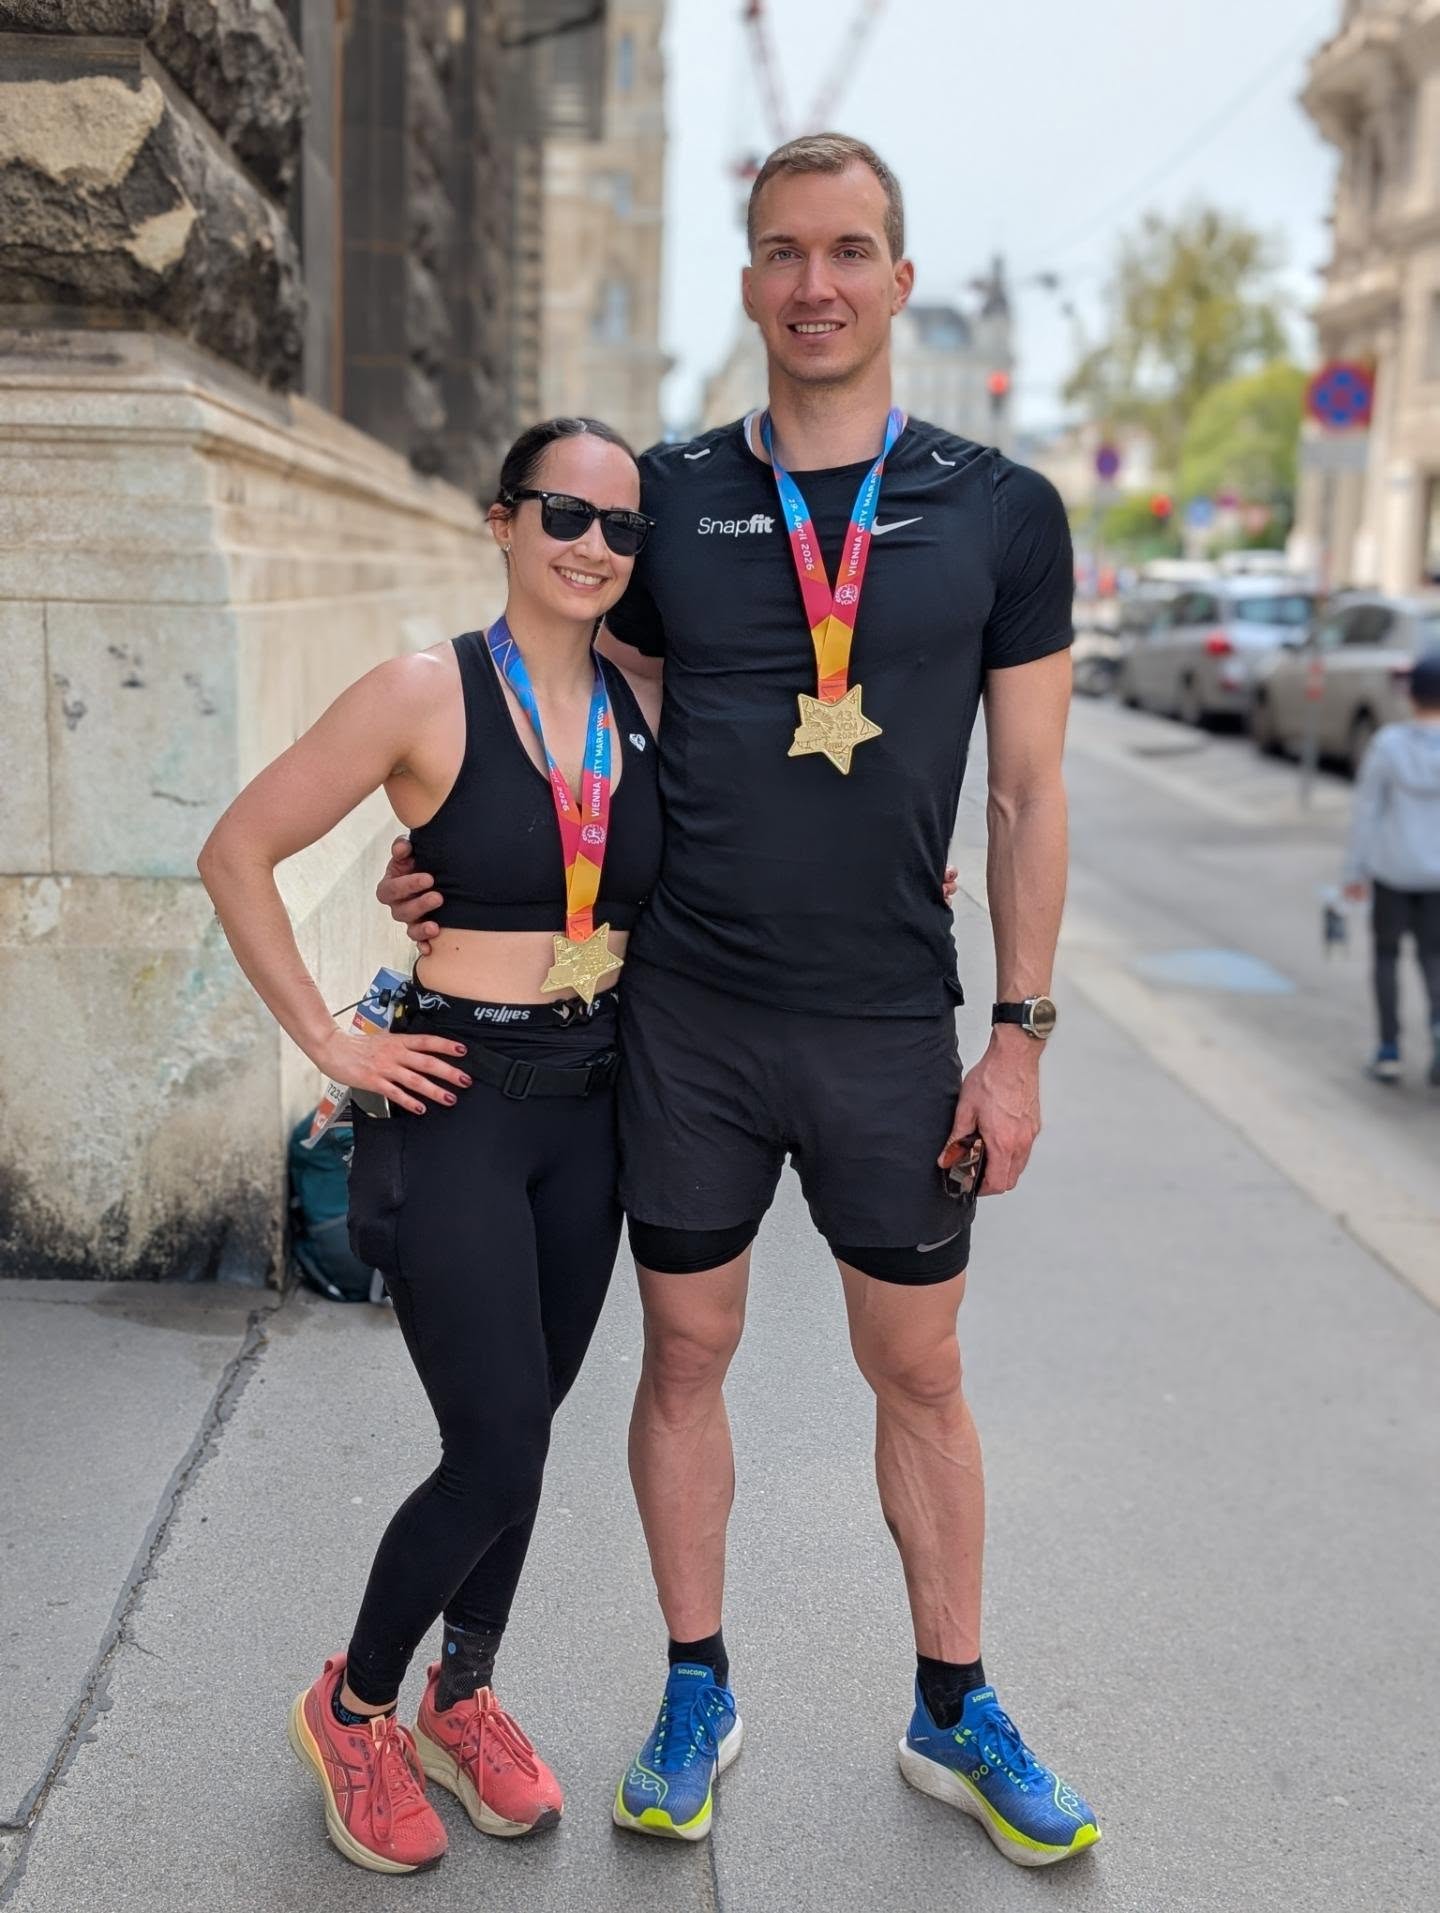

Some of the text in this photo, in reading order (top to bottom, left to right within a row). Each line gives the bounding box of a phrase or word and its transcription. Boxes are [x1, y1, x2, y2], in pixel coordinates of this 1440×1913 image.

[697, 513, 776, 538] Snapfit
[848, 465, 879, 576] VIENNA CITY MARAT
[794, 514, 808, 541] April
[801, 543, 814, 571] 2026
[591, 706, 605, 817] VIENNA CITY MARATHON
[474, 1005, 531, 1022] sailfish
[677, 1668, 707, 1679] saucony
